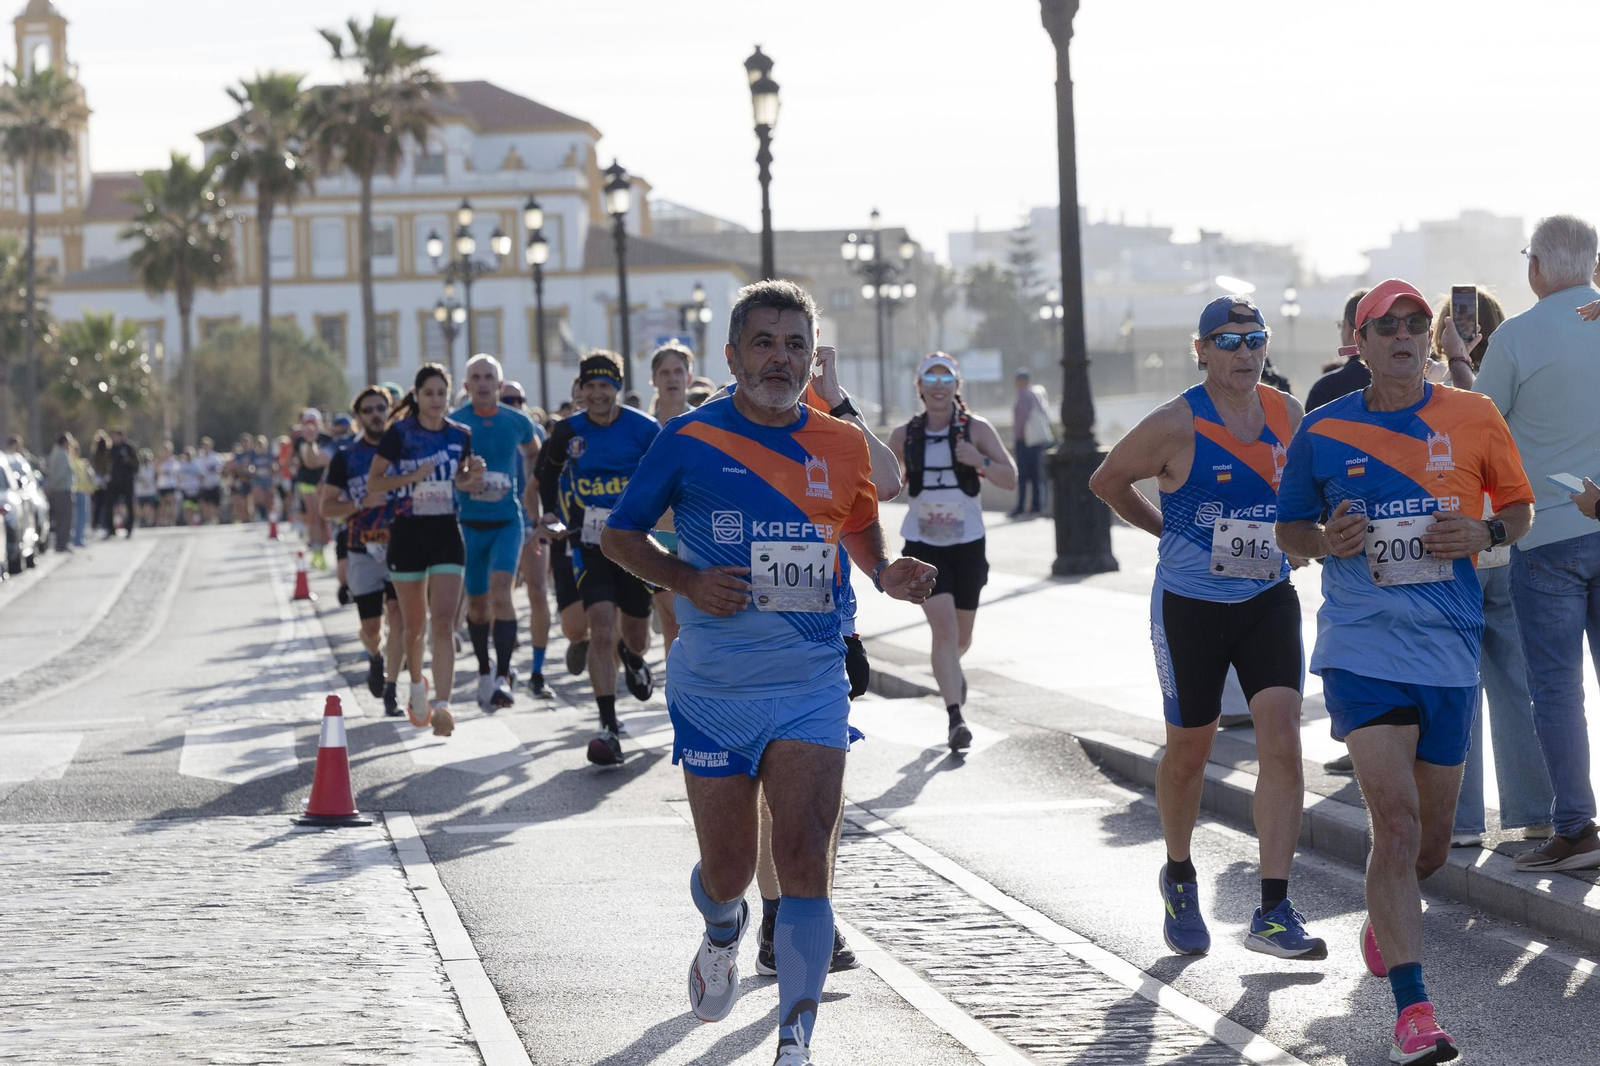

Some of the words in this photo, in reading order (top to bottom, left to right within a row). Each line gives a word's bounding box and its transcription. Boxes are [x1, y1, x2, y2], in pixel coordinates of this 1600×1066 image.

[1345, 456, 1369, 465] mobel
[722, 467, 747, 475] mobel
[1375, 496, 1460, 517] KAEFER
[752, 521, 834, 539] KAEFER
[1230, 537, 1270, 560] 915
[1374, 537, 1432, 563] 200
[767, 562, 826, 588] 1011
[707, 759, 730, 768] REAL
